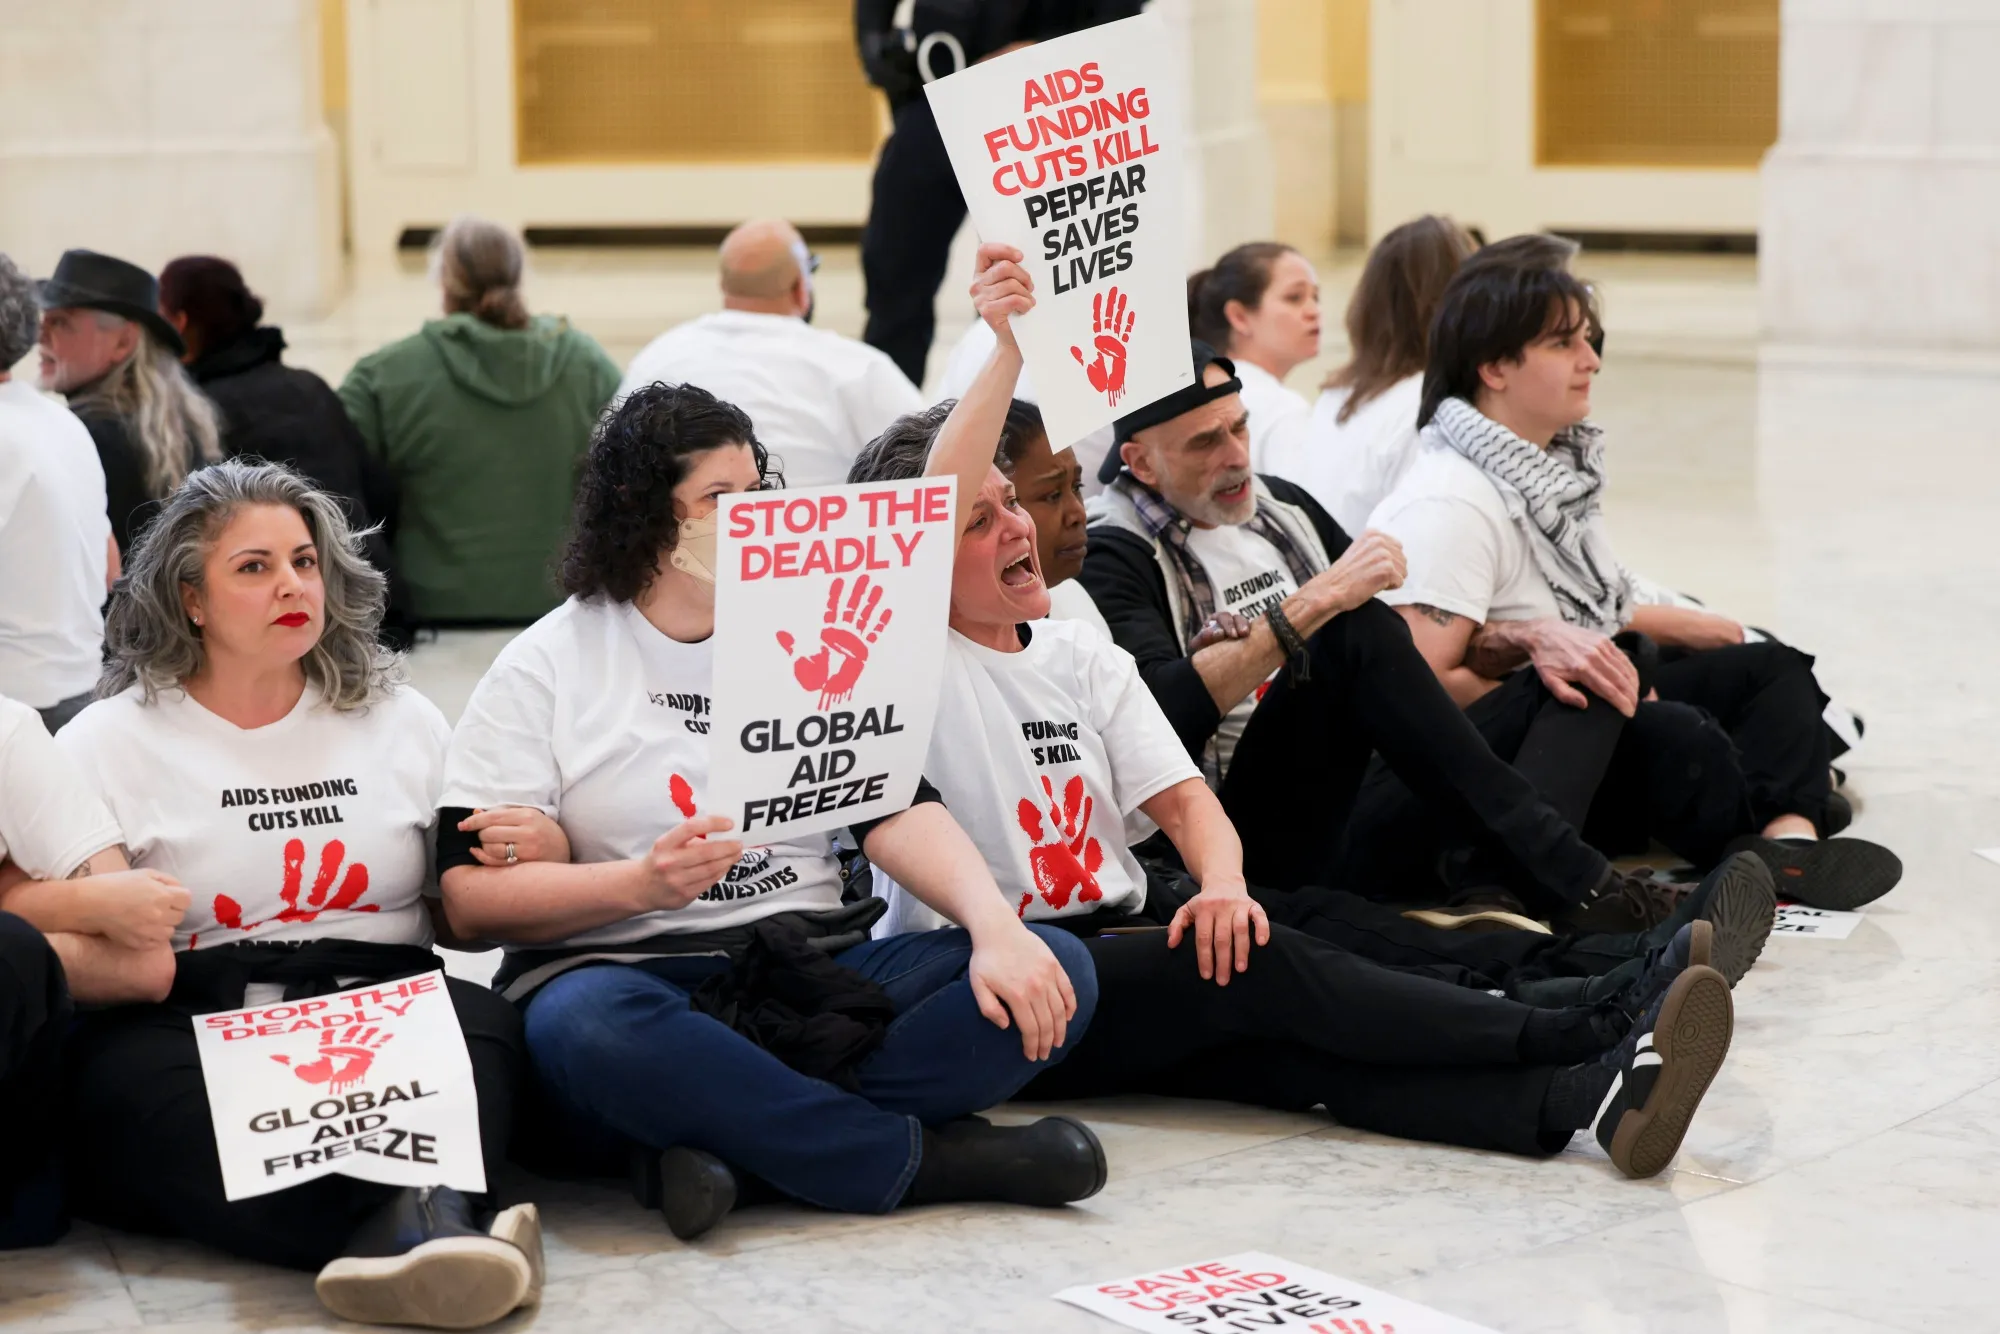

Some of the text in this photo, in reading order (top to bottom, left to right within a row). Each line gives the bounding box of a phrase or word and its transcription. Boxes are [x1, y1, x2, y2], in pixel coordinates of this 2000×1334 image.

[1023, 62, 1104, 113] AIDS
[984, 87, 1150, 163] FUNDING
[992, 125, 1159, 196] CUTS KILL
[1023, 163, 1147, 229] PEPFAR
[1042, 203, 1140, 260] SAVES
[1052, 241, 1133, 295] LIVES
[729, 486, 950, 538] STOP THE
[740, 531, 924, 581] DEADLY
[1223, 585, 1242, 605] IDS
[740, 704, 904, 754] GLOBAL
[787, 749, 856, 789] AID
[1047, 744, 1082, 764] KILL
[221, 778, 358, 808] AIDS FUNDING
[742, 772, 889, 833] FREEZE
[248, 805, 344, 832] CUTS KILL
[754, 866, 798, 895] LIVES
[205, 976, 438, 1029] STOP THE
[222, 999, 415, 1041] DEADLY
[248, 1080, 439, 1133] GLOBAL
[311, 1114, 388, 1144] AID
[263, 1128, 438, 1177] FREEZE
[1097, 1262, 1242, 1299] SAVE
[1128, 1272, 1288, 1311] USAID
[1166, 1284, 1323, 1326] SAVE
